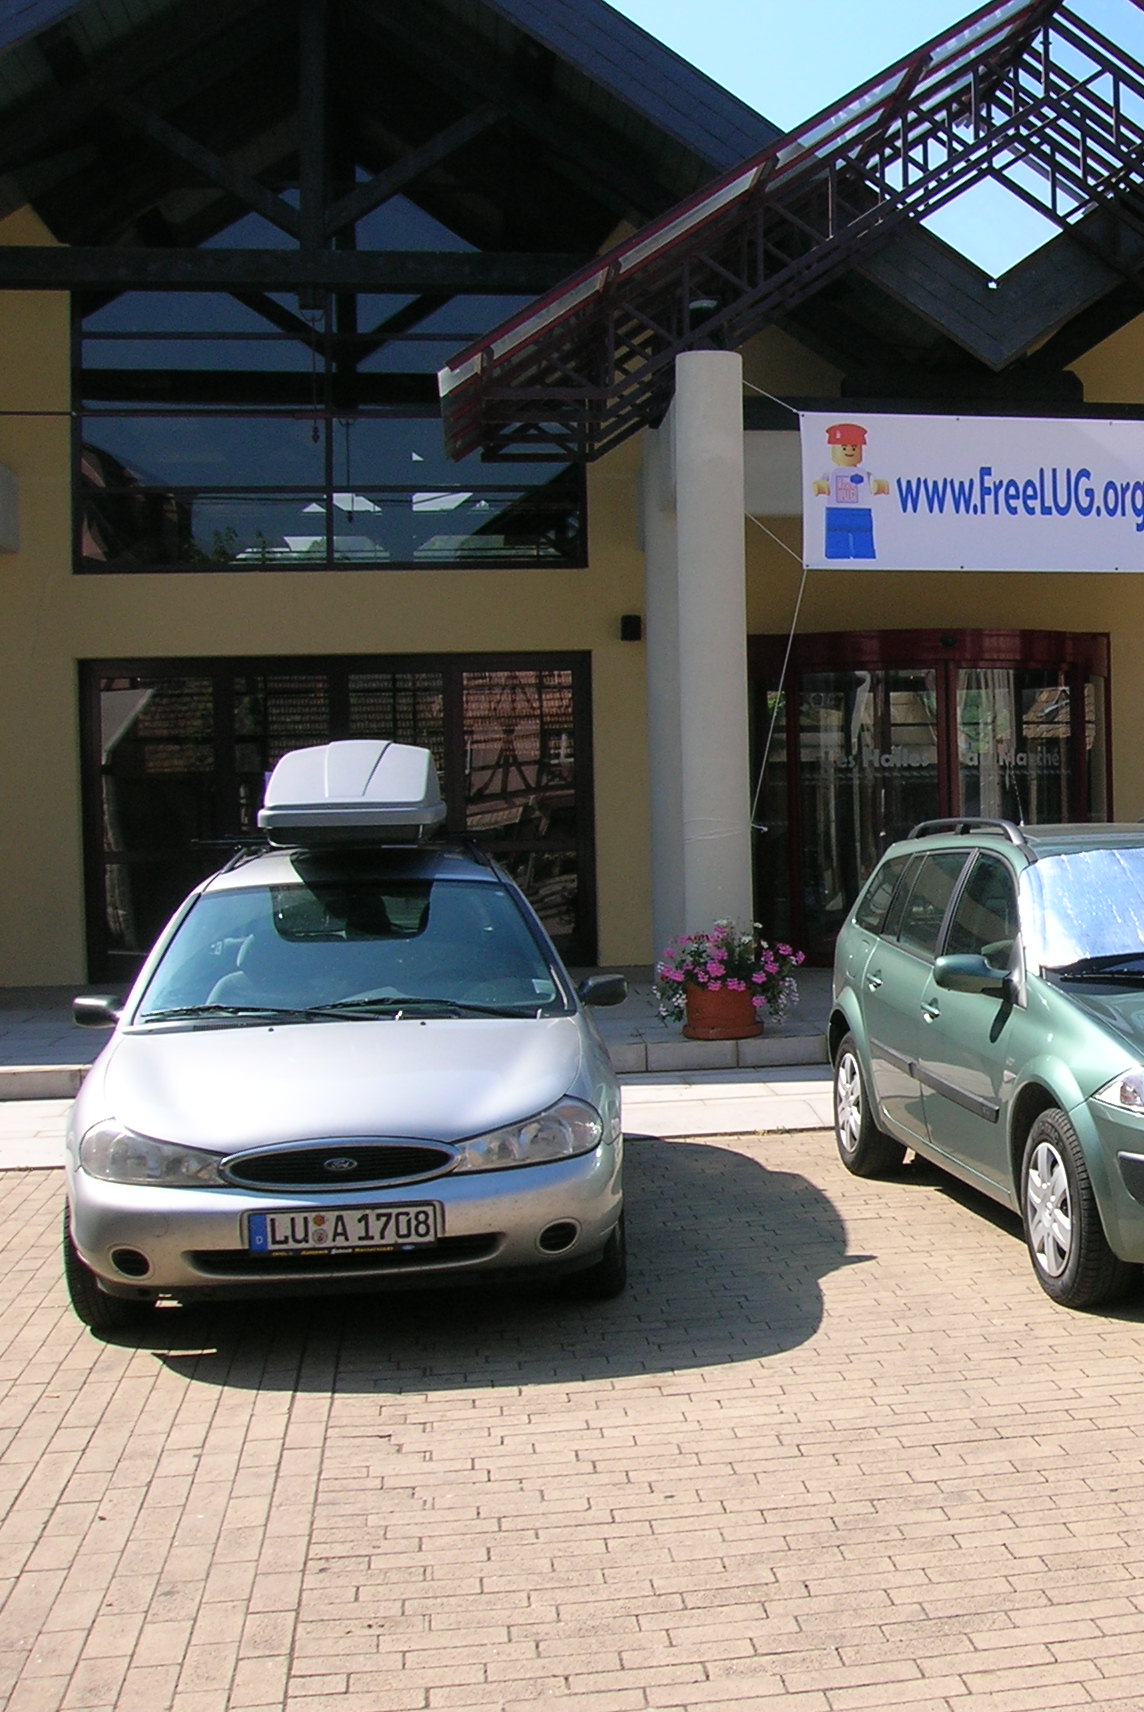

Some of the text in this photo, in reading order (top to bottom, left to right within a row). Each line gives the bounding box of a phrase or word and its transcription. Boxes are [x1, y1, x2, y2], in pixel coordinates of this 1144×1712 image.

[269, 1210, 431, 1246] LU A 1708
[255, 1236, 264, 1246] D
